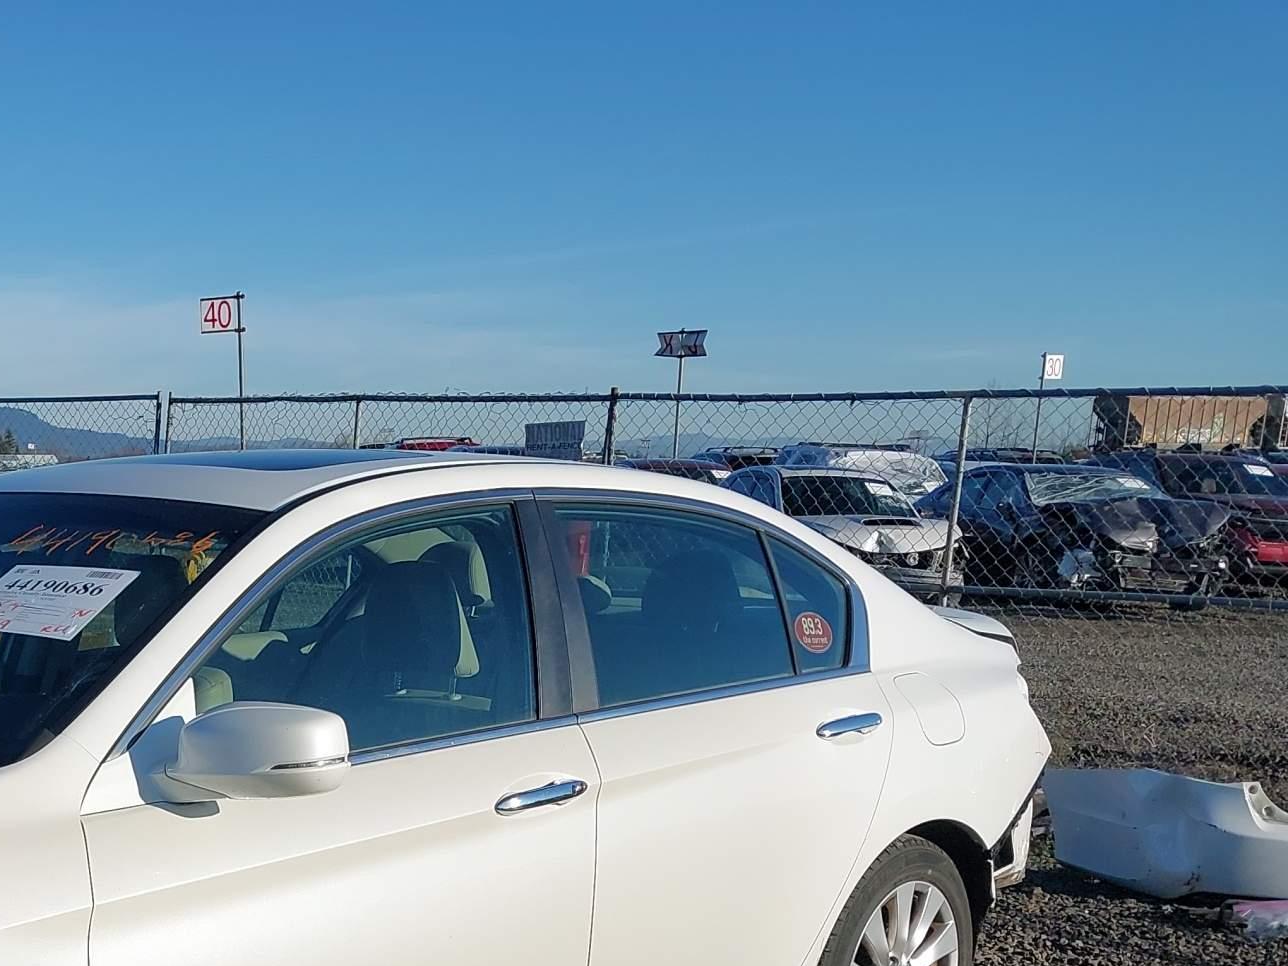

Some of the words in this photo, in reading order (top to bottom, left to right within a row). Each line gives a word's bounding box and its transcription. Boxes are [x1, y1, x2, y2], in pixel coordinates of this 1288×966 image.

[203, 300, 231, 329] 40
[1046, 357, 1061, 377] 30
[5, 578, 109, 597] 44190686
